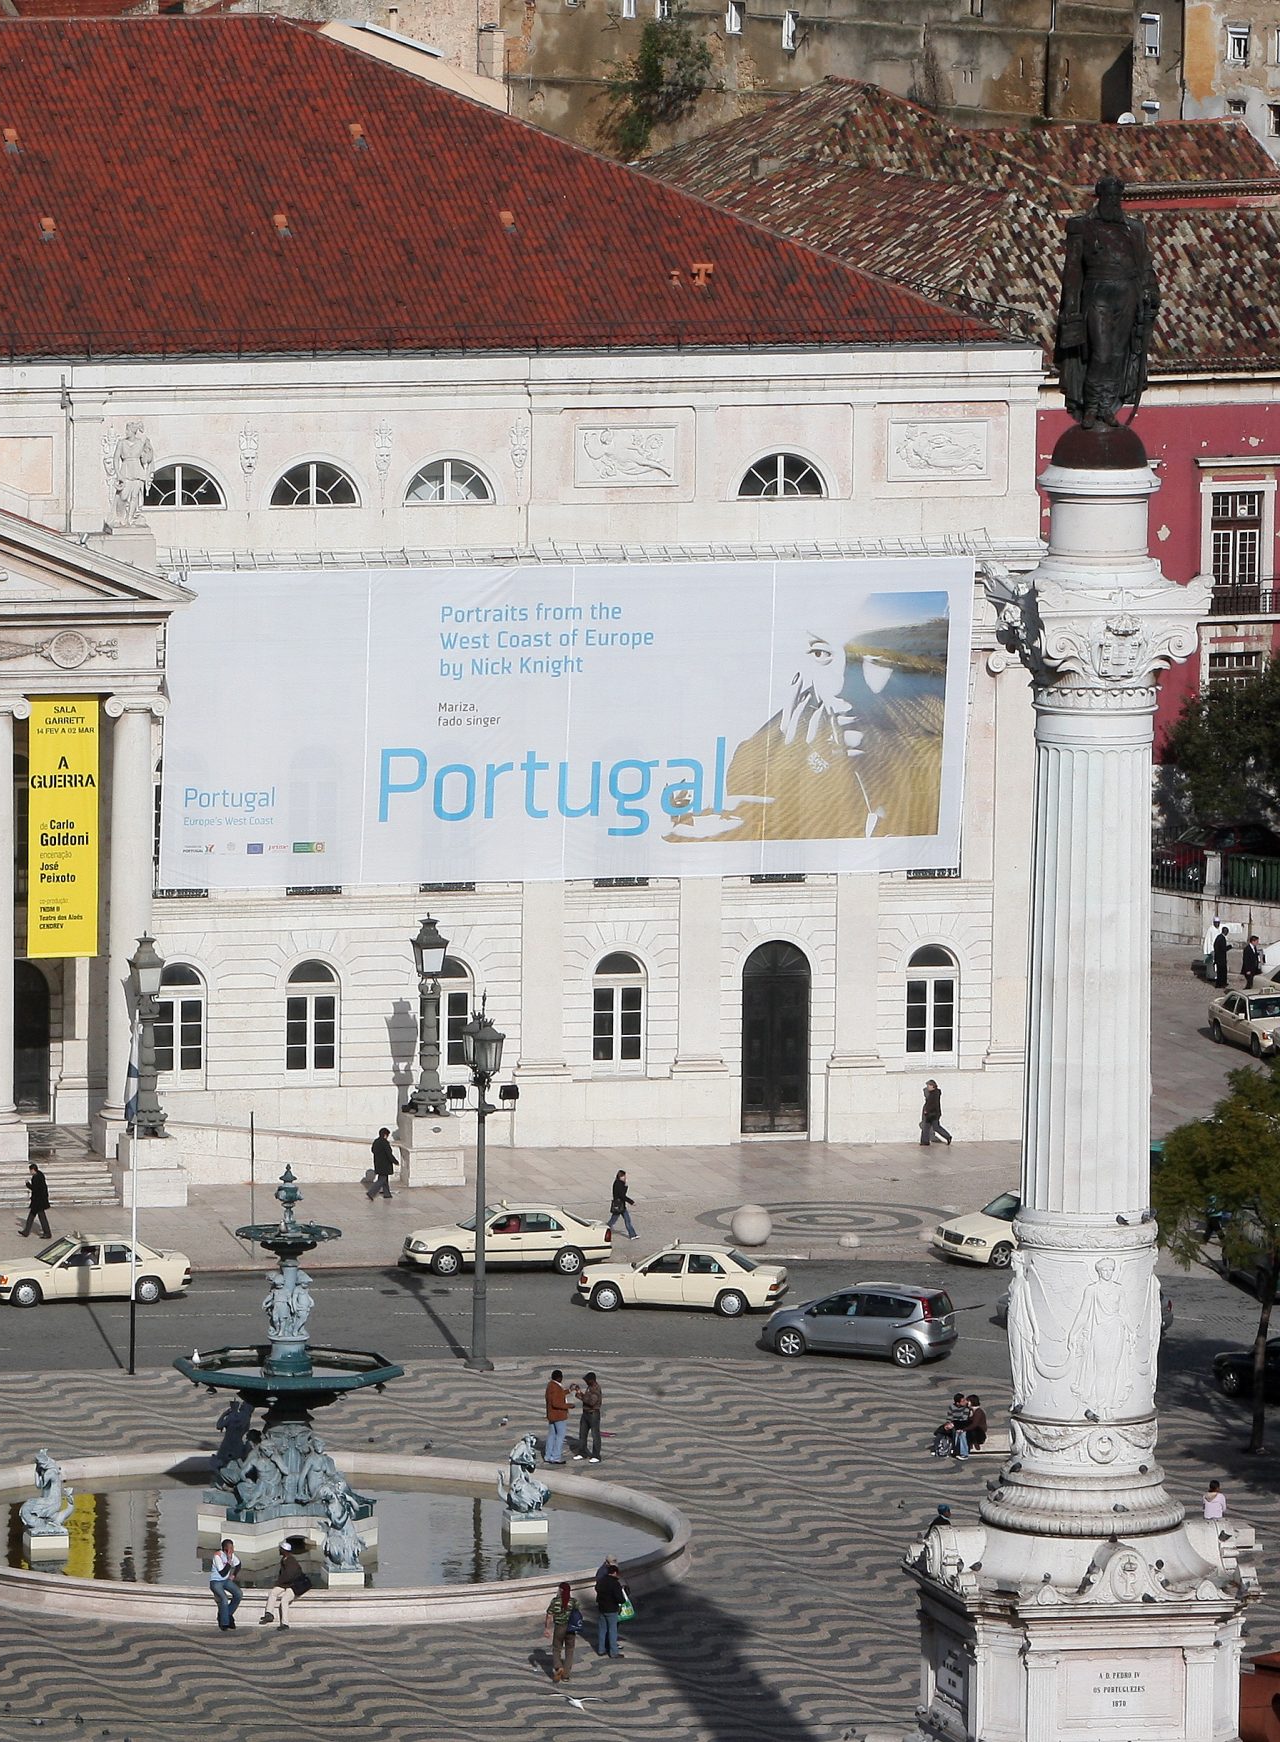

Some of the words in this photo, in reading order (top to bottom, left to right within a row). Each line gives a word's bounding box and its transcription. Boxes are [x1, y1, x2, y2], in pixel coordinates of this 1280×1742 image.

[441, 604, 528, 623] Portraits
[536, 603, 582, 620] from
[590, 602, 622, 620] the
[440, 632, 490, 650] West
[497, 631, 552, 648] Coast
[559, 629, 578, 647] of
[585, 629, 654, 649] Europe
[440, 659, 463, 680] by
[471, 657, 512, 676] Nick
[520, 656, 583, 678] Knight
[438, 702, 478, 713] Mariza,
[438, 715, 462, 727] fado
[466, 715, 500, 727] singer
[58, 756, 69, 769] A
[31, 774, 96, 788] GUERRA
[378, 737, 725, 837] Portugal
[184, 787, 275, 812] Portugal
[50, 819, 75, 830] Carlo
[184, 817, 222, 827] Europe's
[225, 817, 247, 825] West
[249, 817, 273, 825] Coast
[41, 832, 89, 846] Goldoni
[40, 850, 72, 860] encenação
[40, 862, 59, 871] José
[40, 873, 76, 883] Peixoto
